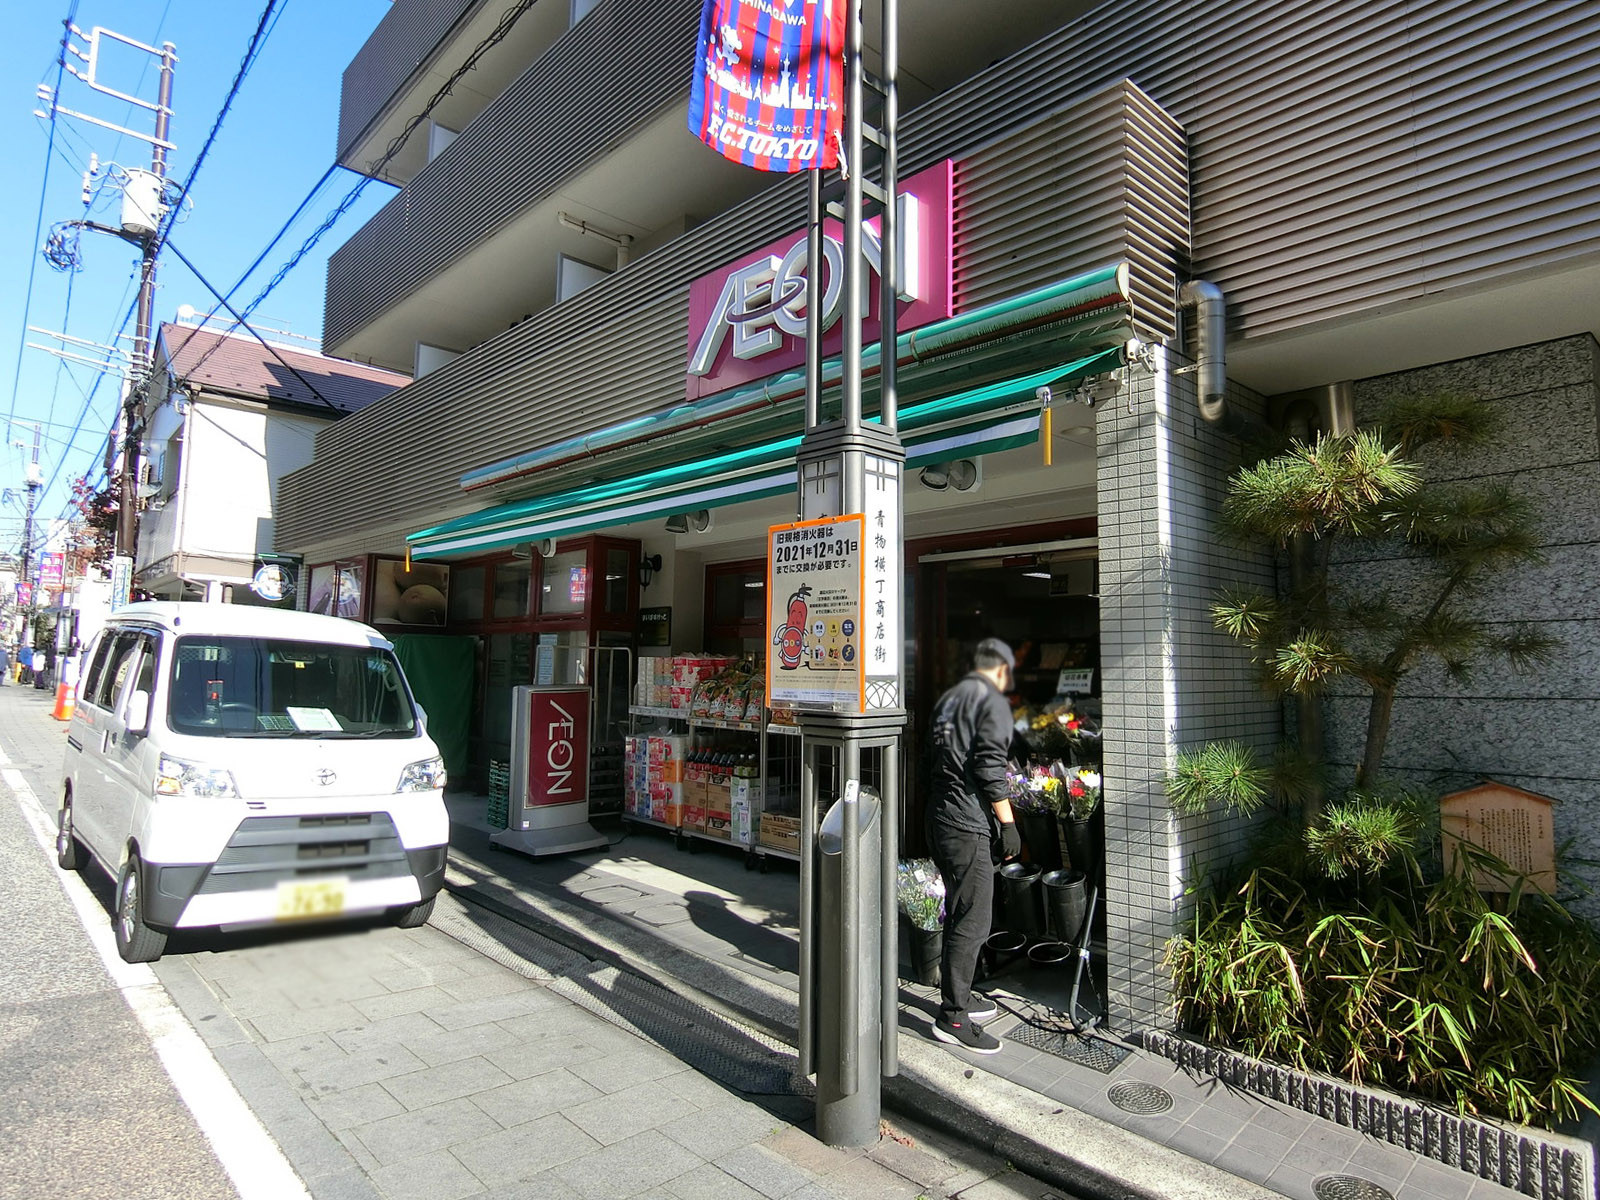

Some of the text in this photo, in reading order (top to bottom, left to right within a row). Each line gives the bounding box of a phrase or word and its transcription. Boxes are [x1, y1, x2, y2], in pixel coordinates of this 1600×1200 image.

[776, 527, 834, 544] 旧規格消火器は
[776, 539, 858, 563] 2021年12月31日
[776, 559, 852, 574] までに交換が必要です。
[874, 509, 886, 664] 青物横丁商店街
[547, 699, 574, 795] AEON
